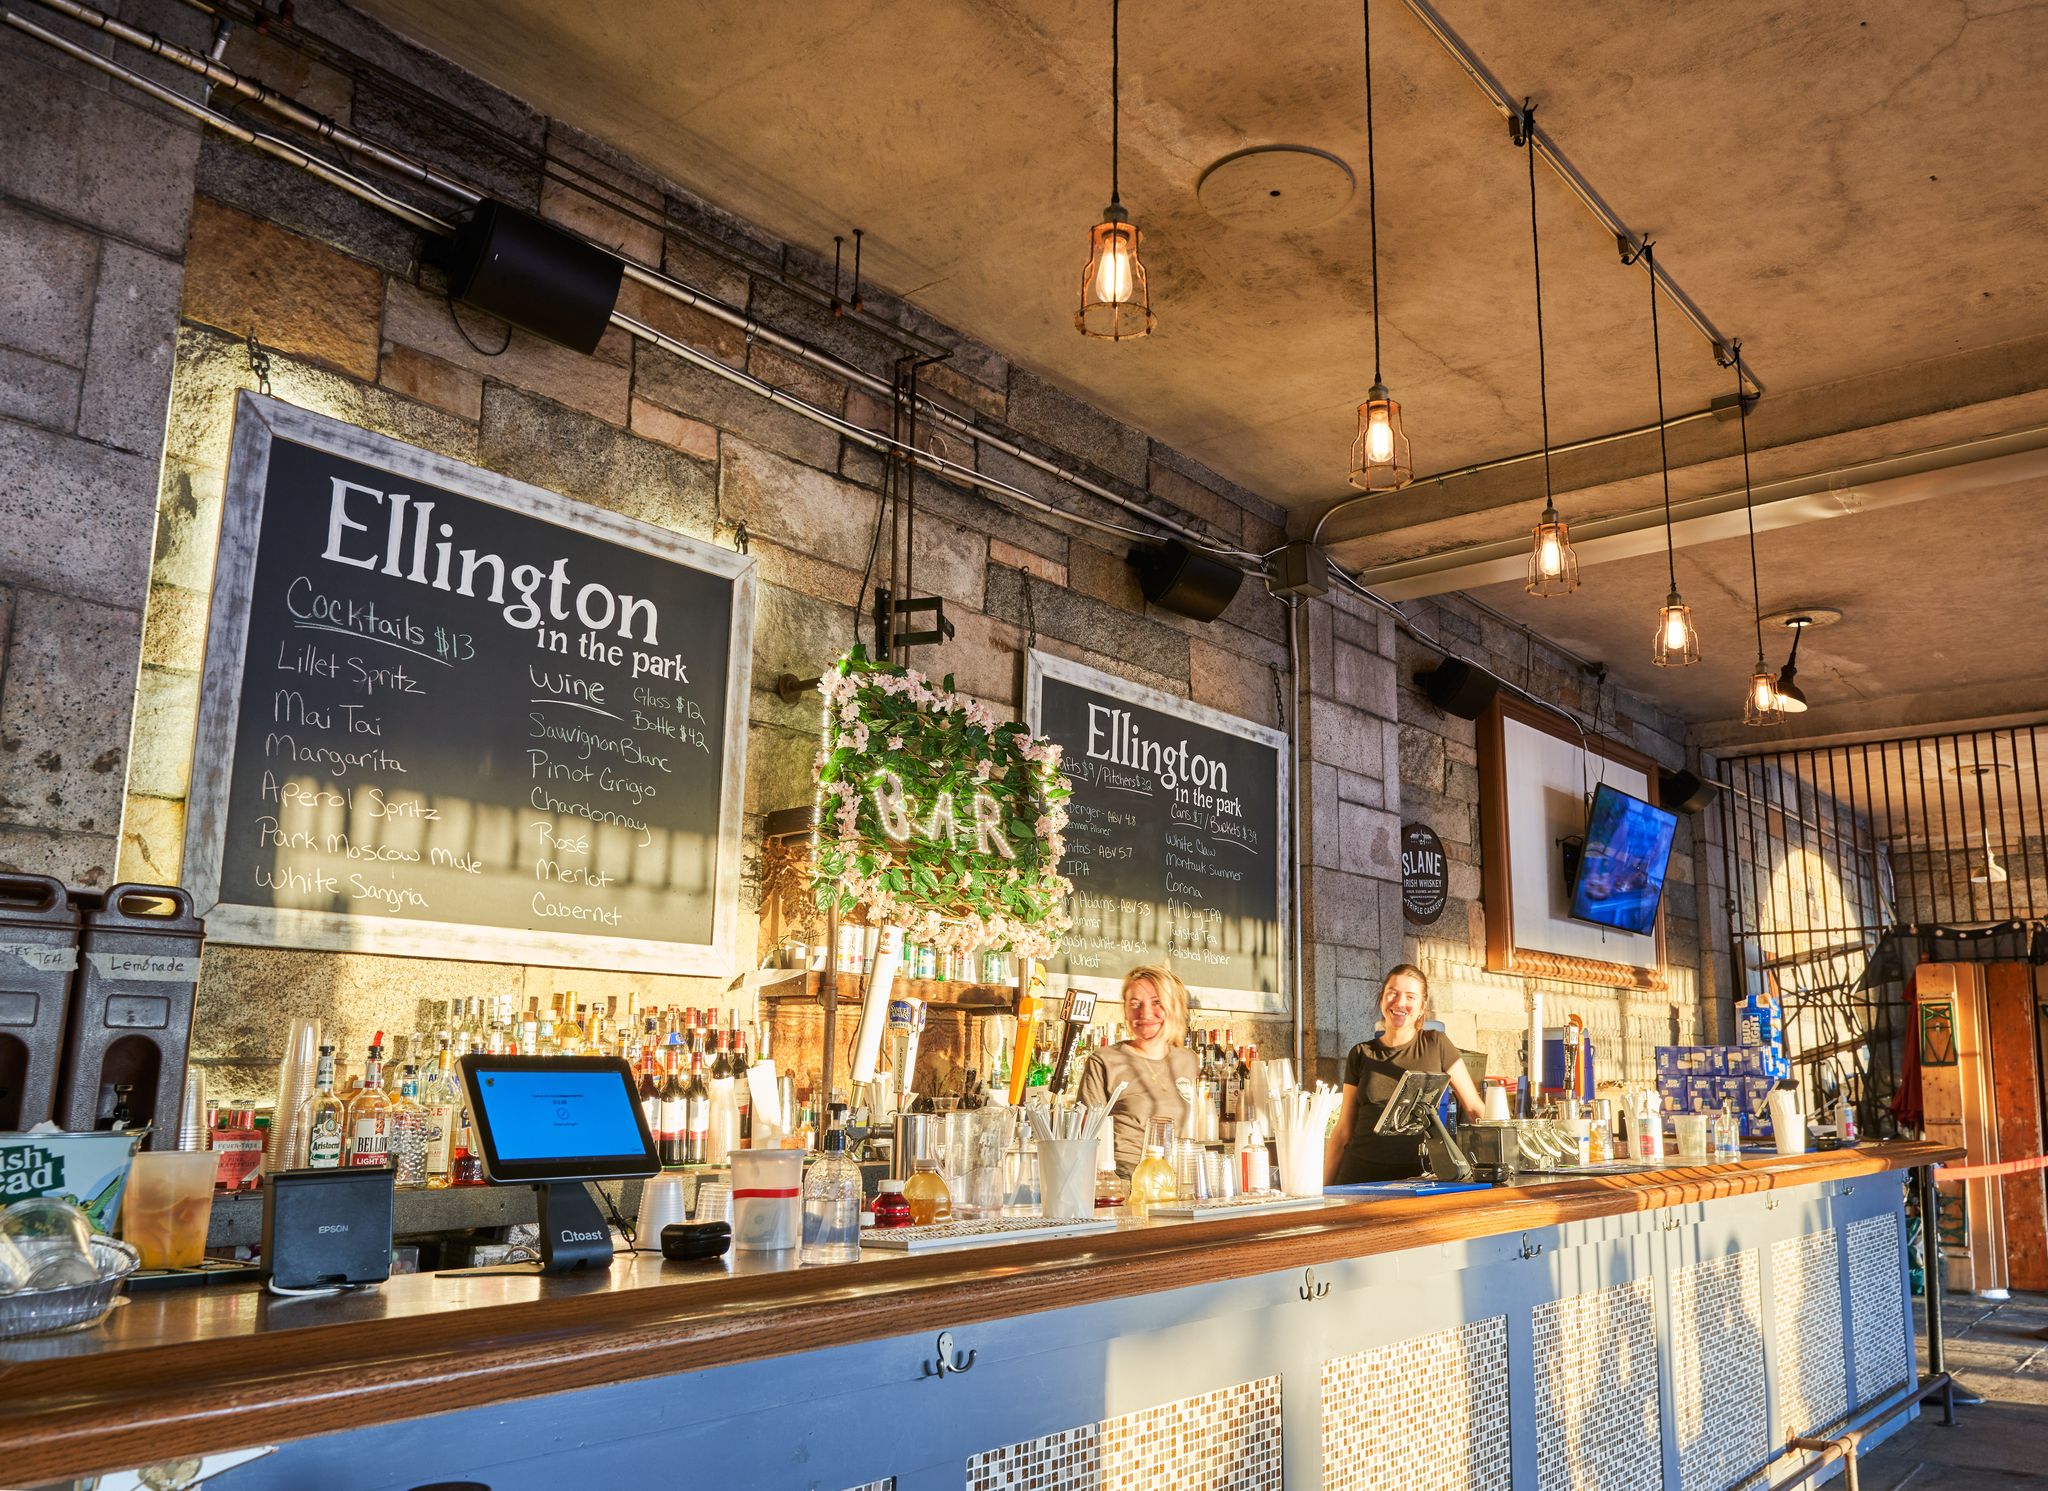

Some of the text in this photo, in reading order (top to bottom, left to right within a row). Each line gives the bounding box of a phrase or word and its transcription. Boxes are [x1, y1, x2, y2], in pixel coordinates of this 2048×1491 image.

[321, 476, 659, 646] Ellington
[287, 576, 475, 661] Cocktails $13
[277, 639, 427, 695] Lillet Spritz
[537, 620, 690, 684] in the park
[529, 664, 606, 705] Wine
[275, 689, 381, 737] Mai Tai
[633, 686, 706, 726] Glass $12
[529, 712, 672, 773] Sauvignon Blanc
[631, 709, 710, 754] Bottle $42
[1085, 702, 1229, 793] Ellington
[265, 732, 408, 776] Margarita
[1060, 756, 1081, 774] afts
[526, 749, 656, 805] Pinot Grigio
[261, 769, 441, 822] Aperol Spritz
[1170, 803, 1192, 821] Cans
[1175, 782, 1243, 818] in the park
[530, 786, 651, 848] Chardonnay
[872, 766, 1017, 861] BAR
[255, 815, 482, 874] Park Moscow Mule
[529, 821, 590, 855] Rosé
[1098, 844, 1117, 859] ABV
[1165, 832, 1217, 857] White Claw
[536, 858, 616, 888] Merlot
[1065, 859, 1091, 877] IPA
[1208, 863, 1243, 881] Summer
[1402, 850, 1442, 877] SLANE
[255, 864, 430, 913] White Sangria
[1079, 889, 1116, 912] Adams
[1165, 871, 1204, 899] Corona
[1403, 879, 1442, 888] IRISH WHISKEY
[531, 891, 623, 927] Cabernet
[1167, 897, 1223, 931] All Day IPA
[1166, 921, 1219, 945] Twisted Tea
[110, 955, 186, 973] Lemonade
[1069, 952, 1101, 968] Wheat
[1072, 999, 1092, 1017] IPA
[1742, 1019, 1752, 1045] BUD
[0, 1147, 43, 1173] ish
[356, 1158, 379, 1166] LIGHT
[318, 1224, 350, 1234] EPSON
[573, 1230, 604, 1241] toast
